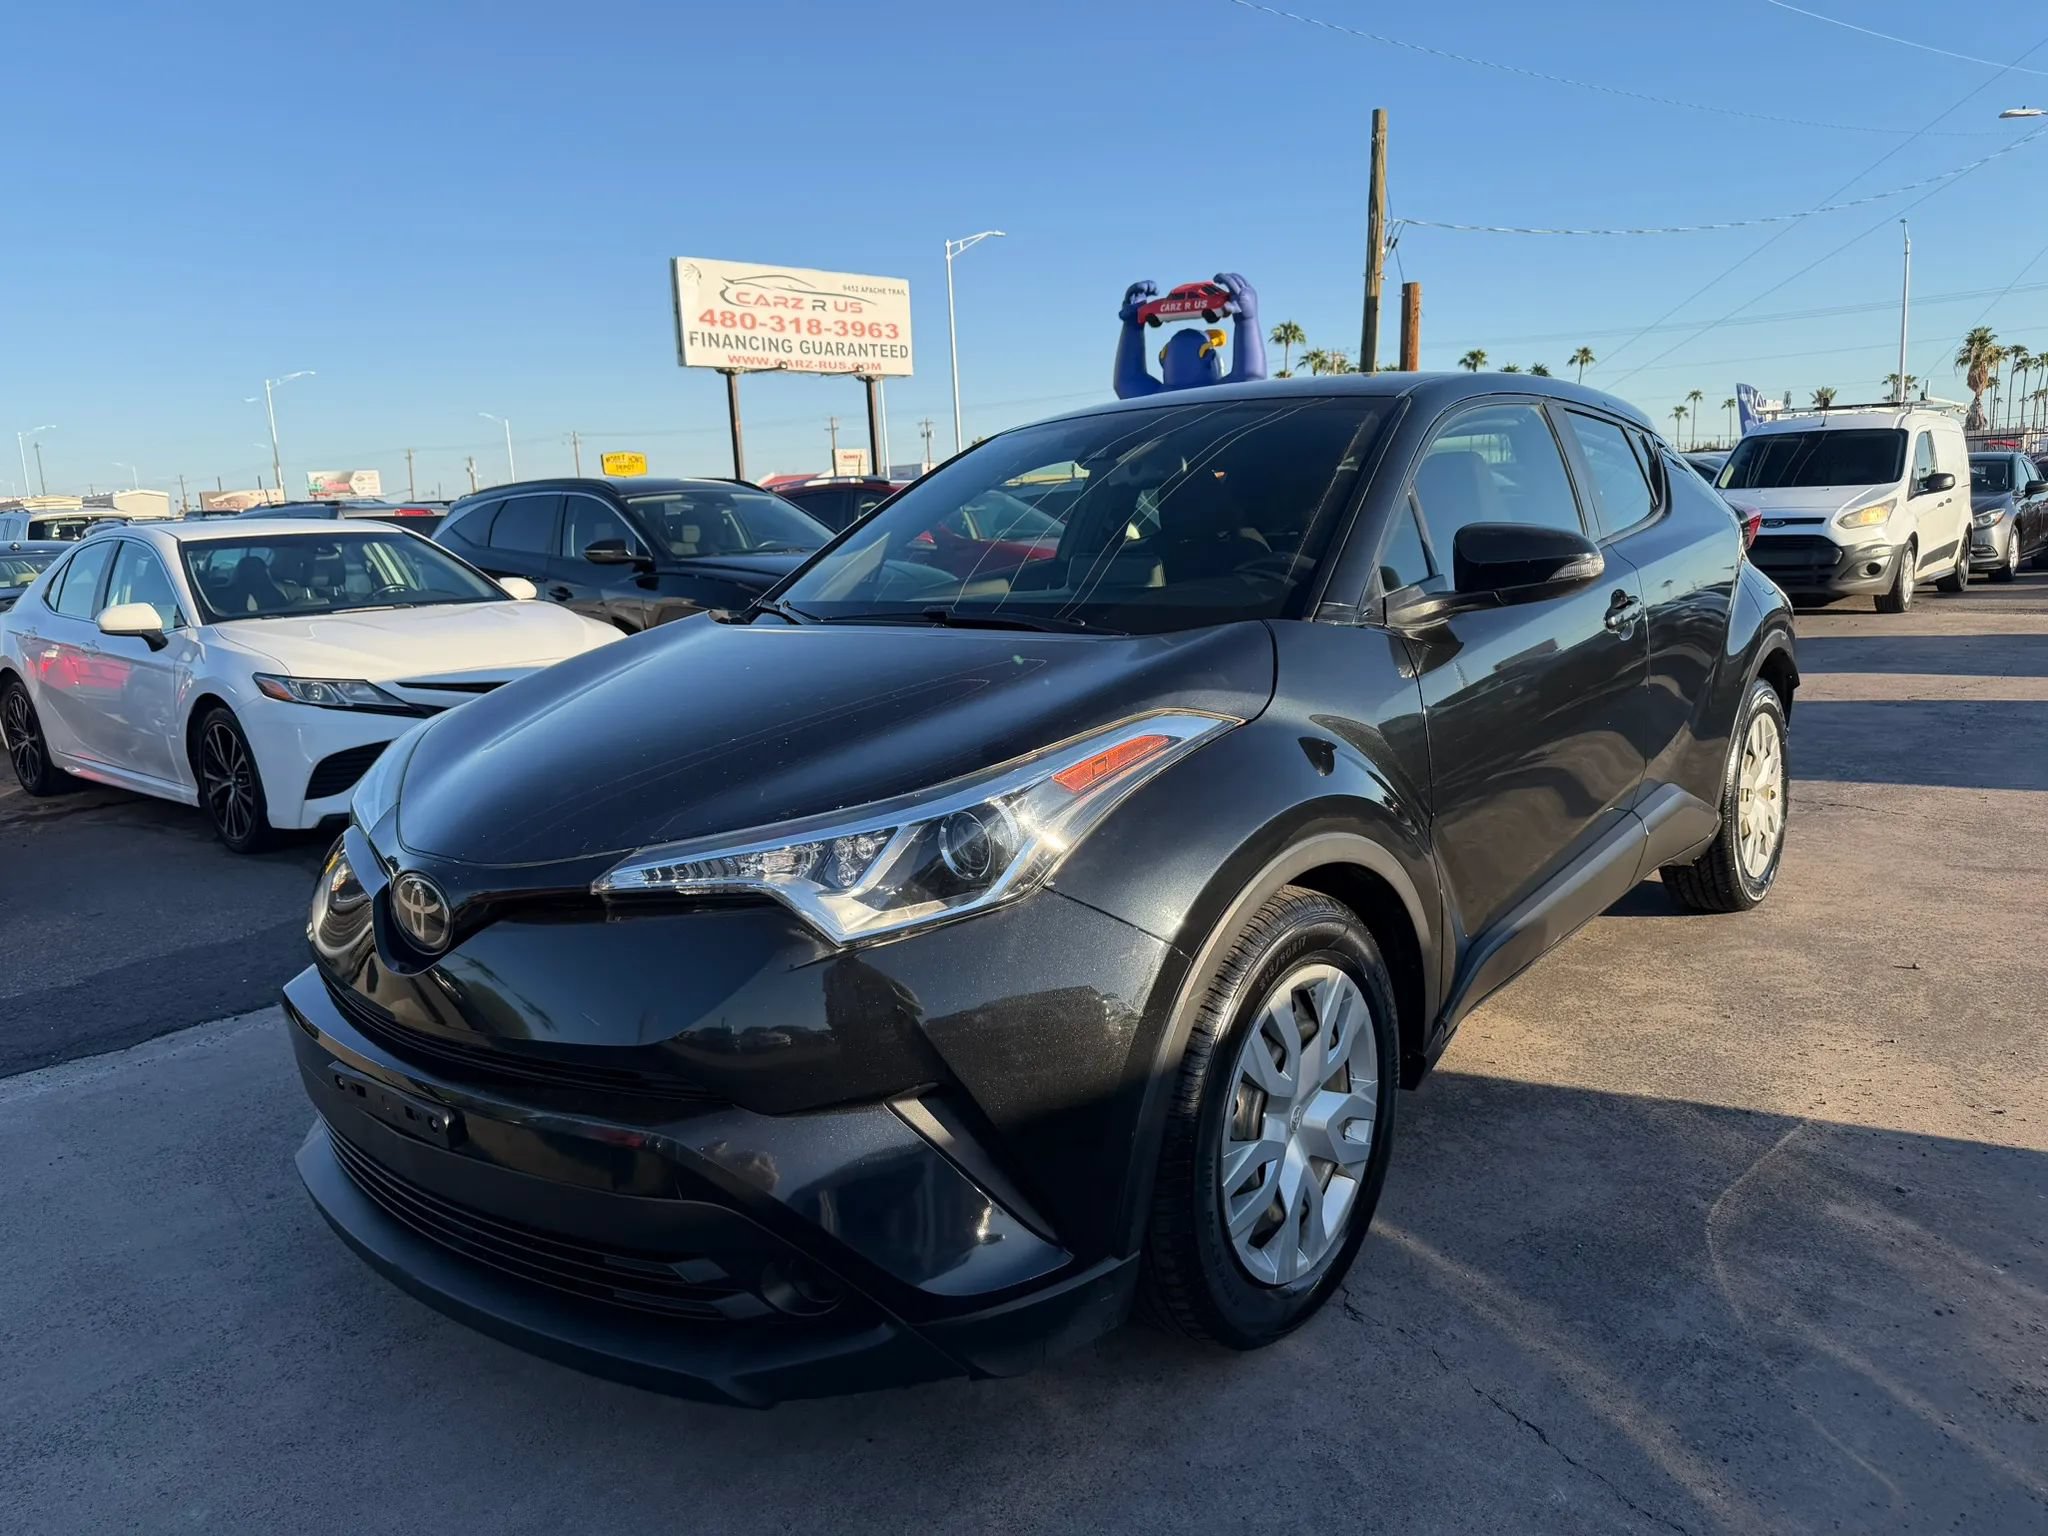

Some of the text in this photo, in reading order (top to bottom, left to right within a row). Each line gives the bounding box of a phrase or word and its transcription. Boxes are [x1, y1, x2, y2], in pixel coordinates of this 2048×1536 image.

[736, 291, 864, 314] CARZ R US
[861, 286, 886, 295] APACHE
[888, 288, 907, 296] TRAIL
[1160, 300, 1208, 313] CARZ R US
[699, 308, 900, 340] 480-318-3963
[689, 330, 909, 359] FINANCING GUARANTEED
